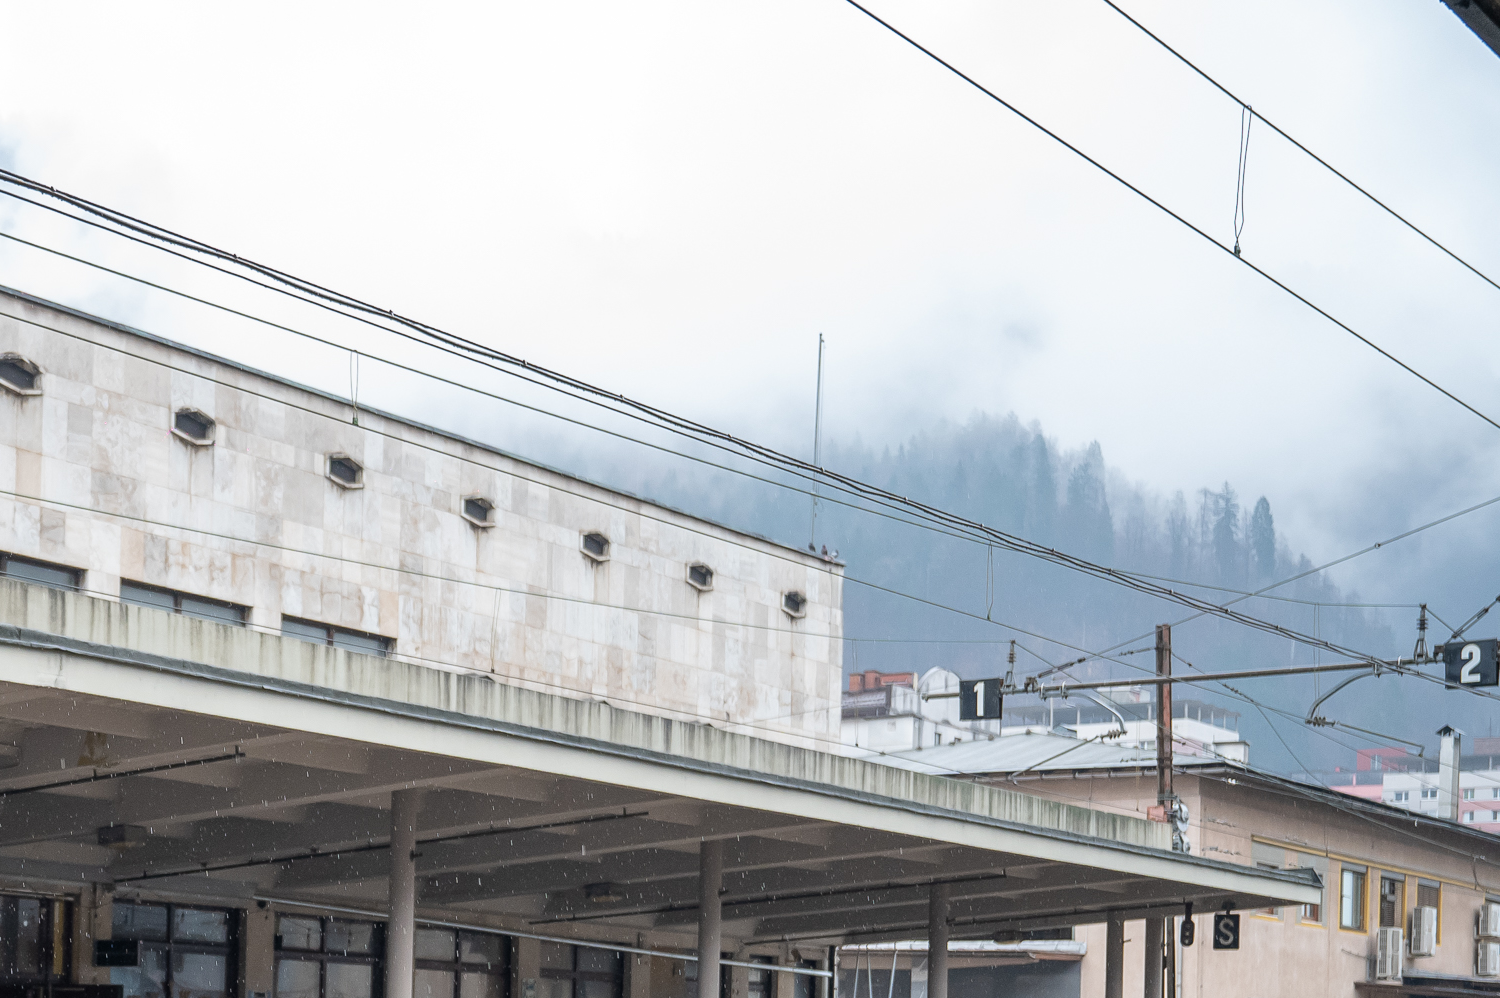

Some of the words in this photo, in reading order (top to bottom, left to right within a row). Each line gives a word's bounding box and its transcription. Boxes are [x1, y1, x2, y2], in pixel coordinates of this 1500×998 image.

[1460, 643, 1481, 684] 2
[973, 681, 985, 717] 1
[1219, 918, 1235, 946] S
